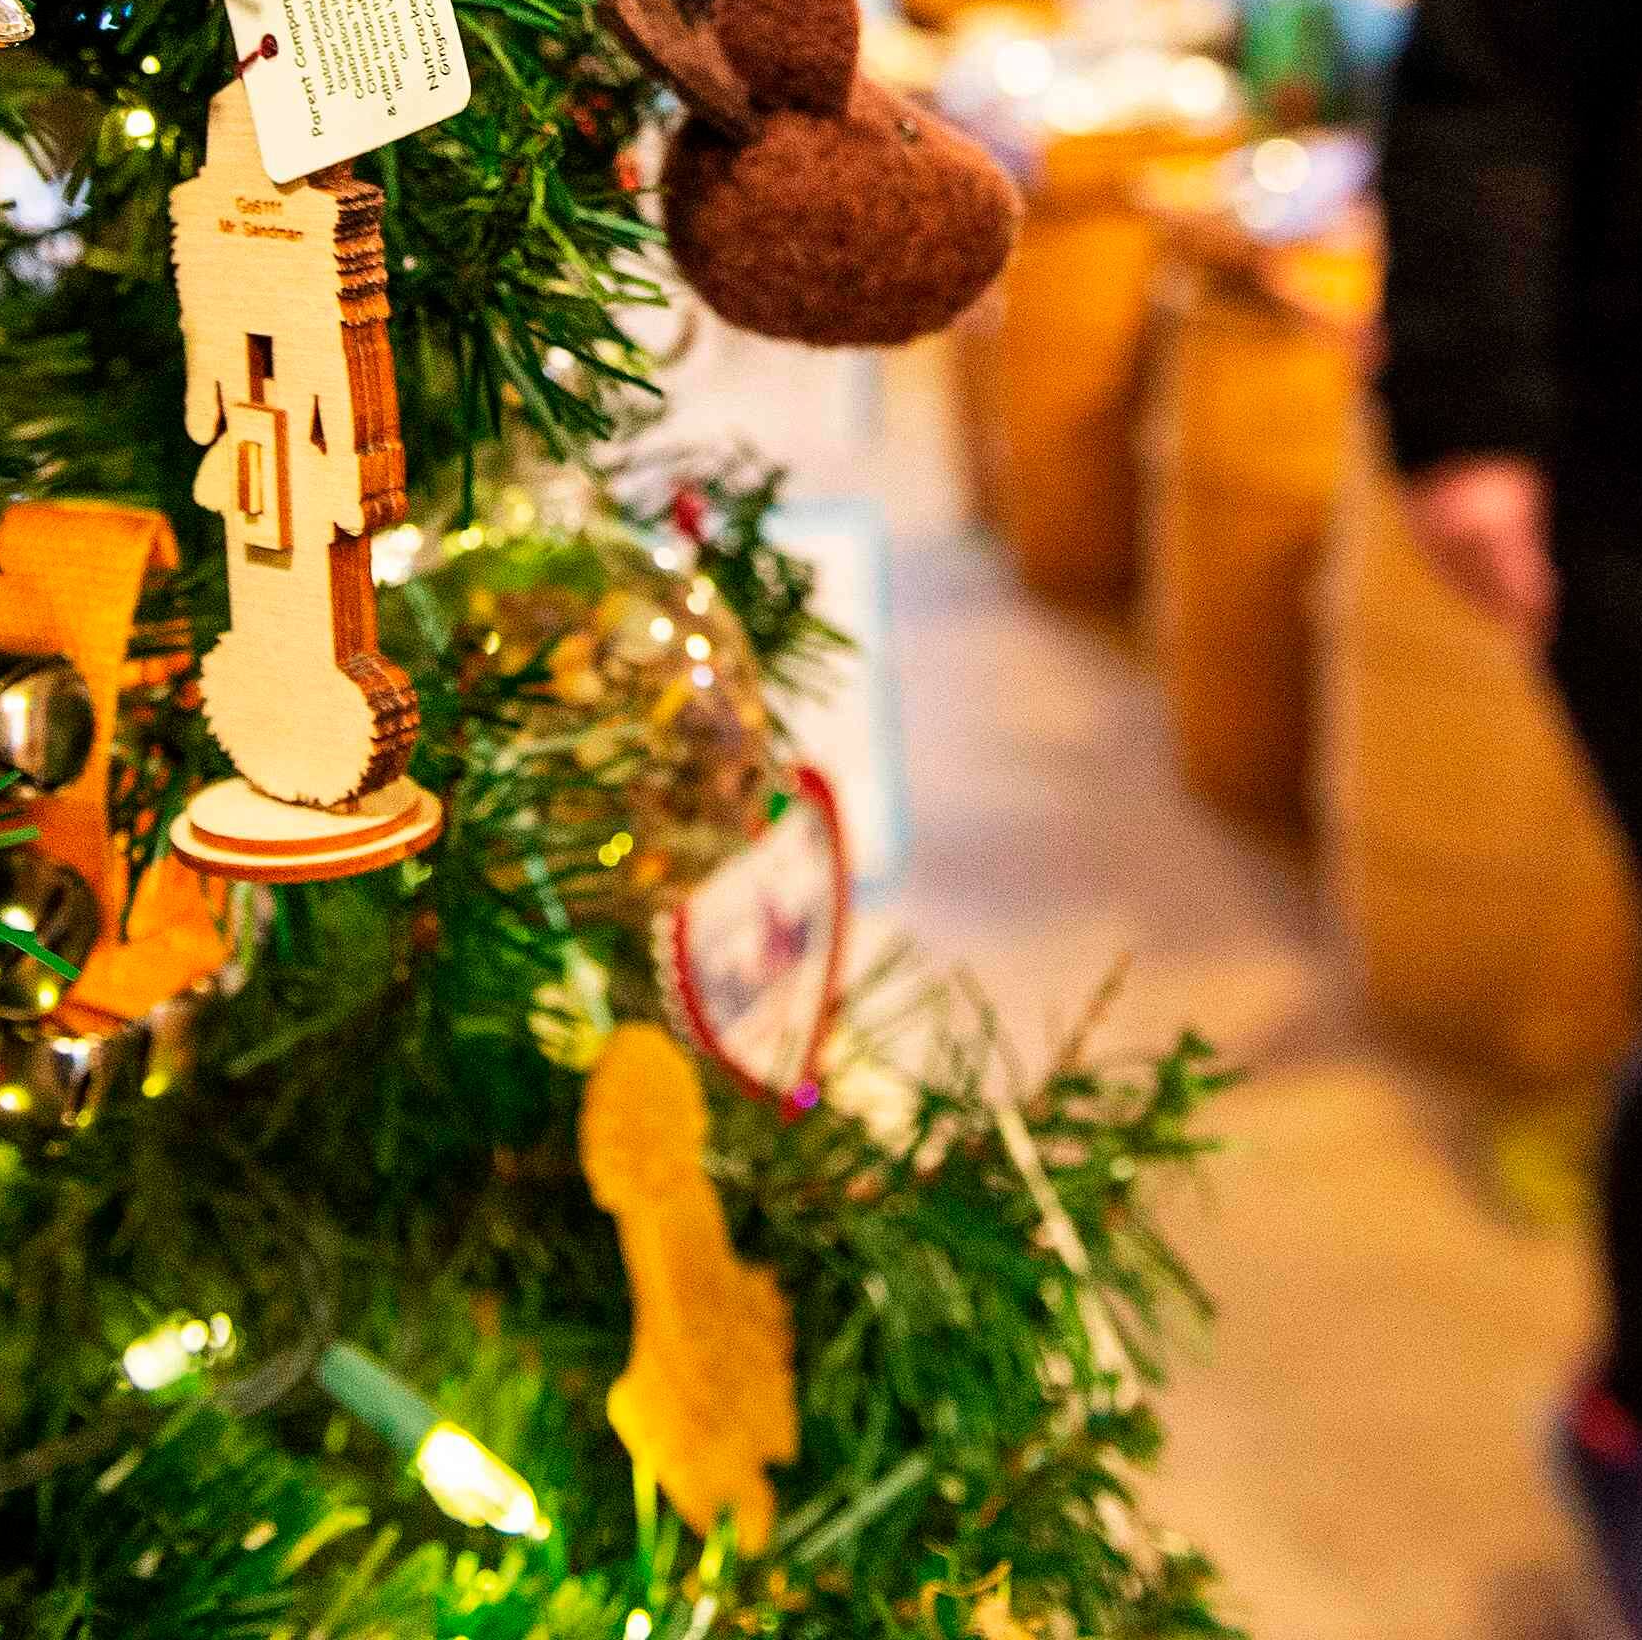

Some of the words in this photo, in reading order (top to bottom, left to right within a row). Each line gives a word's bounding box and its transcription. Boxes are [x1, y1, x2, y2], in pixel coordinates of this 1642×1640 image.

[334, 8, 365, 100] Celebrations
[377, 14, 392, 48] from
[387, 10, 409, 60] central
[329, 42, 348, 90] Ginger
[351, 20, 377, 95] Christmas
[387, 50, 404, 92] items
[300, 75, 324, 137] Parent
[375, 64, 393, 102] other
[386, 104, 397, 117] &
